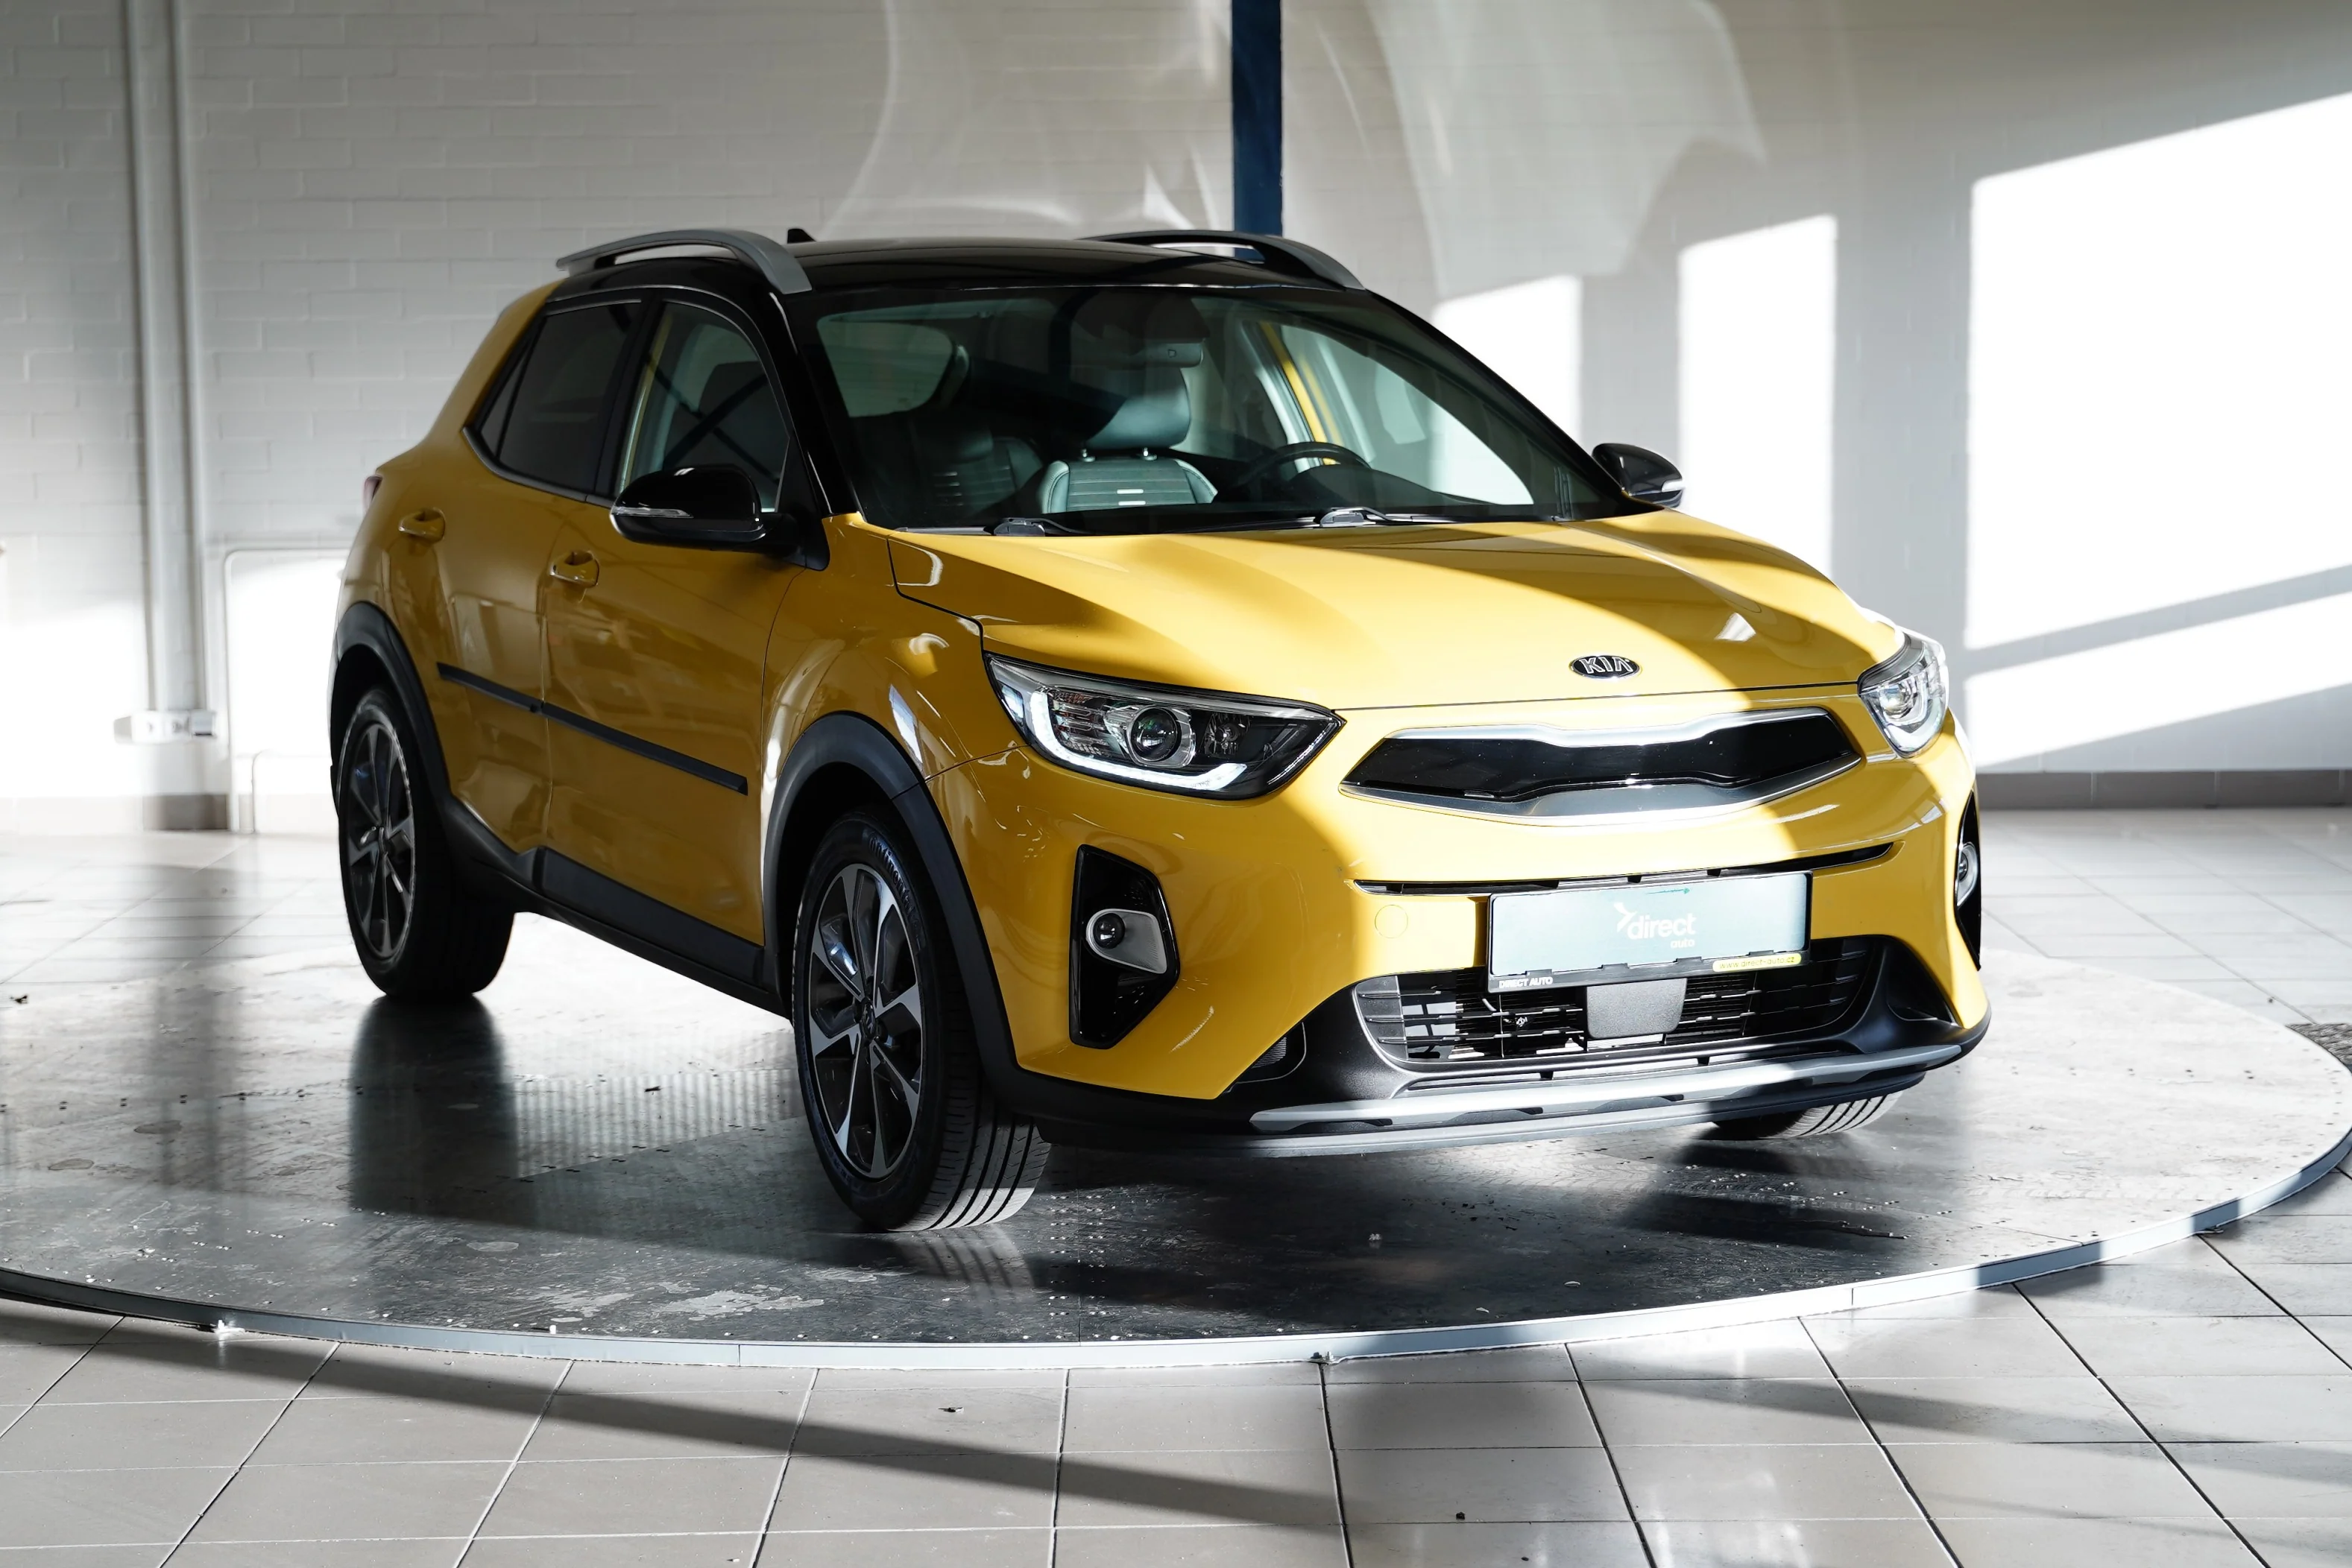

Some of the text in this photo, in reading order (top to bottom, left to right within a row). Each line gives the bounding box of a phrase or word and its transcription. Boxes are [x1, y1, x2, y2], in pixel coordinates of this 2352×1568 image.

[1579, 657, 1633, 674] KIA
[1627, 913, 1697, 940] direct
[1671, 938, 1695, 949] auto
[1498, 976, 1554, 989] DIRECT AUTO
